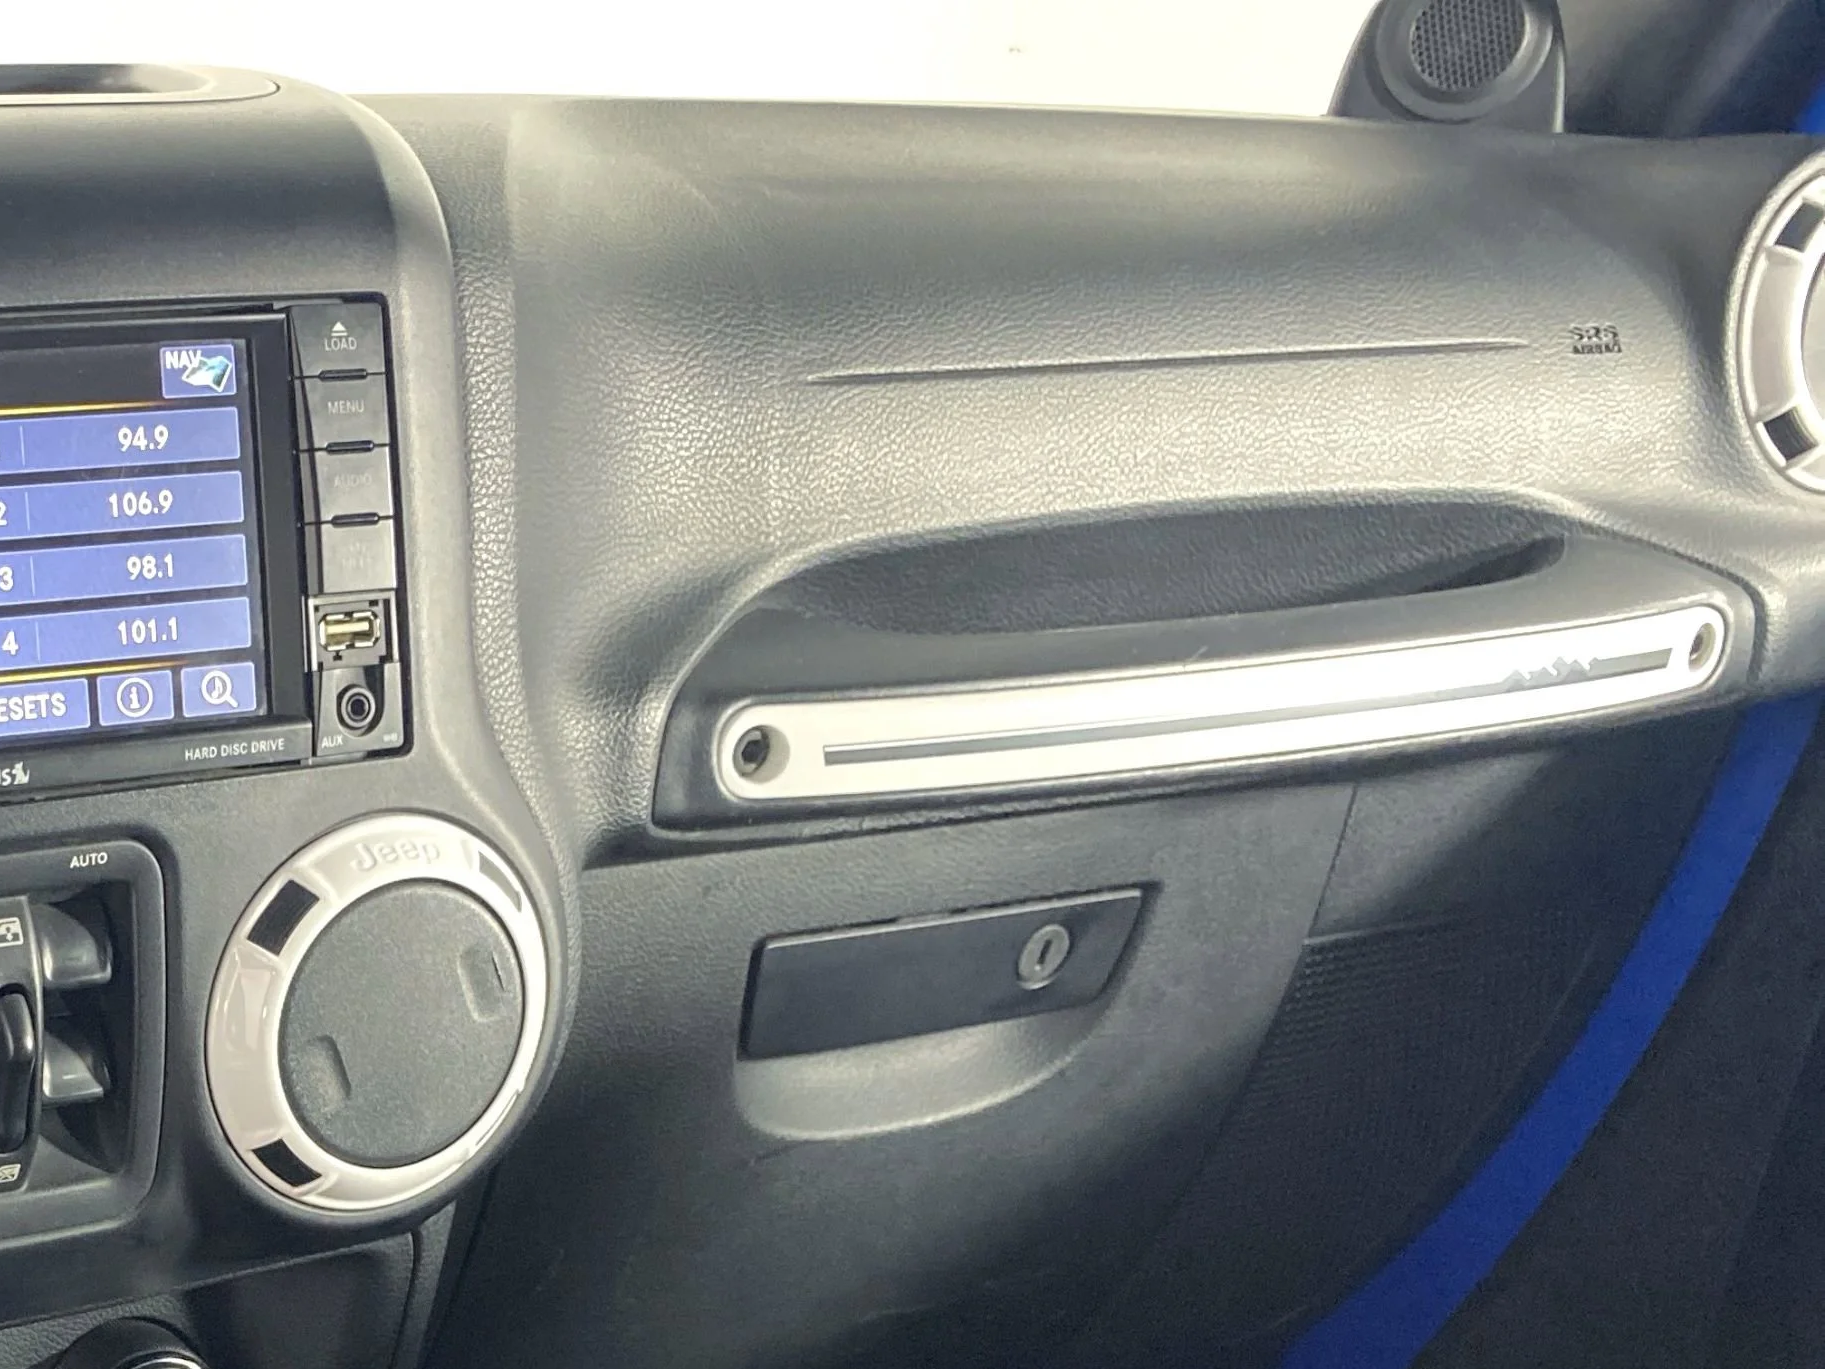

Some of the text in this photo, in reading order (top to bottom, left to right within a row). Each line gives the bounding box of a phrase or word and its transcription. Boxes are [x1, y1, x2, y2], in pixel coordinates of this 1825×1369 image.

[324, 336, 357, 352] LOAD
[165, 351, 201, 370] NAV
[327, 399, 364, 415] MENU
[117, 425, 169, 452] 94.9
[109, 490, 173, 519] 106.9
[127, 554, 174, 581] 98.1
[2, 617, 178, 656] 4 101.1
[184, 737, 285, 761] HARD DISC DRIVE
[321, 734, 344, 750] AUX
[70, 851, 109, 869] AUTO
[350, 838, 441, 873] Jeep
